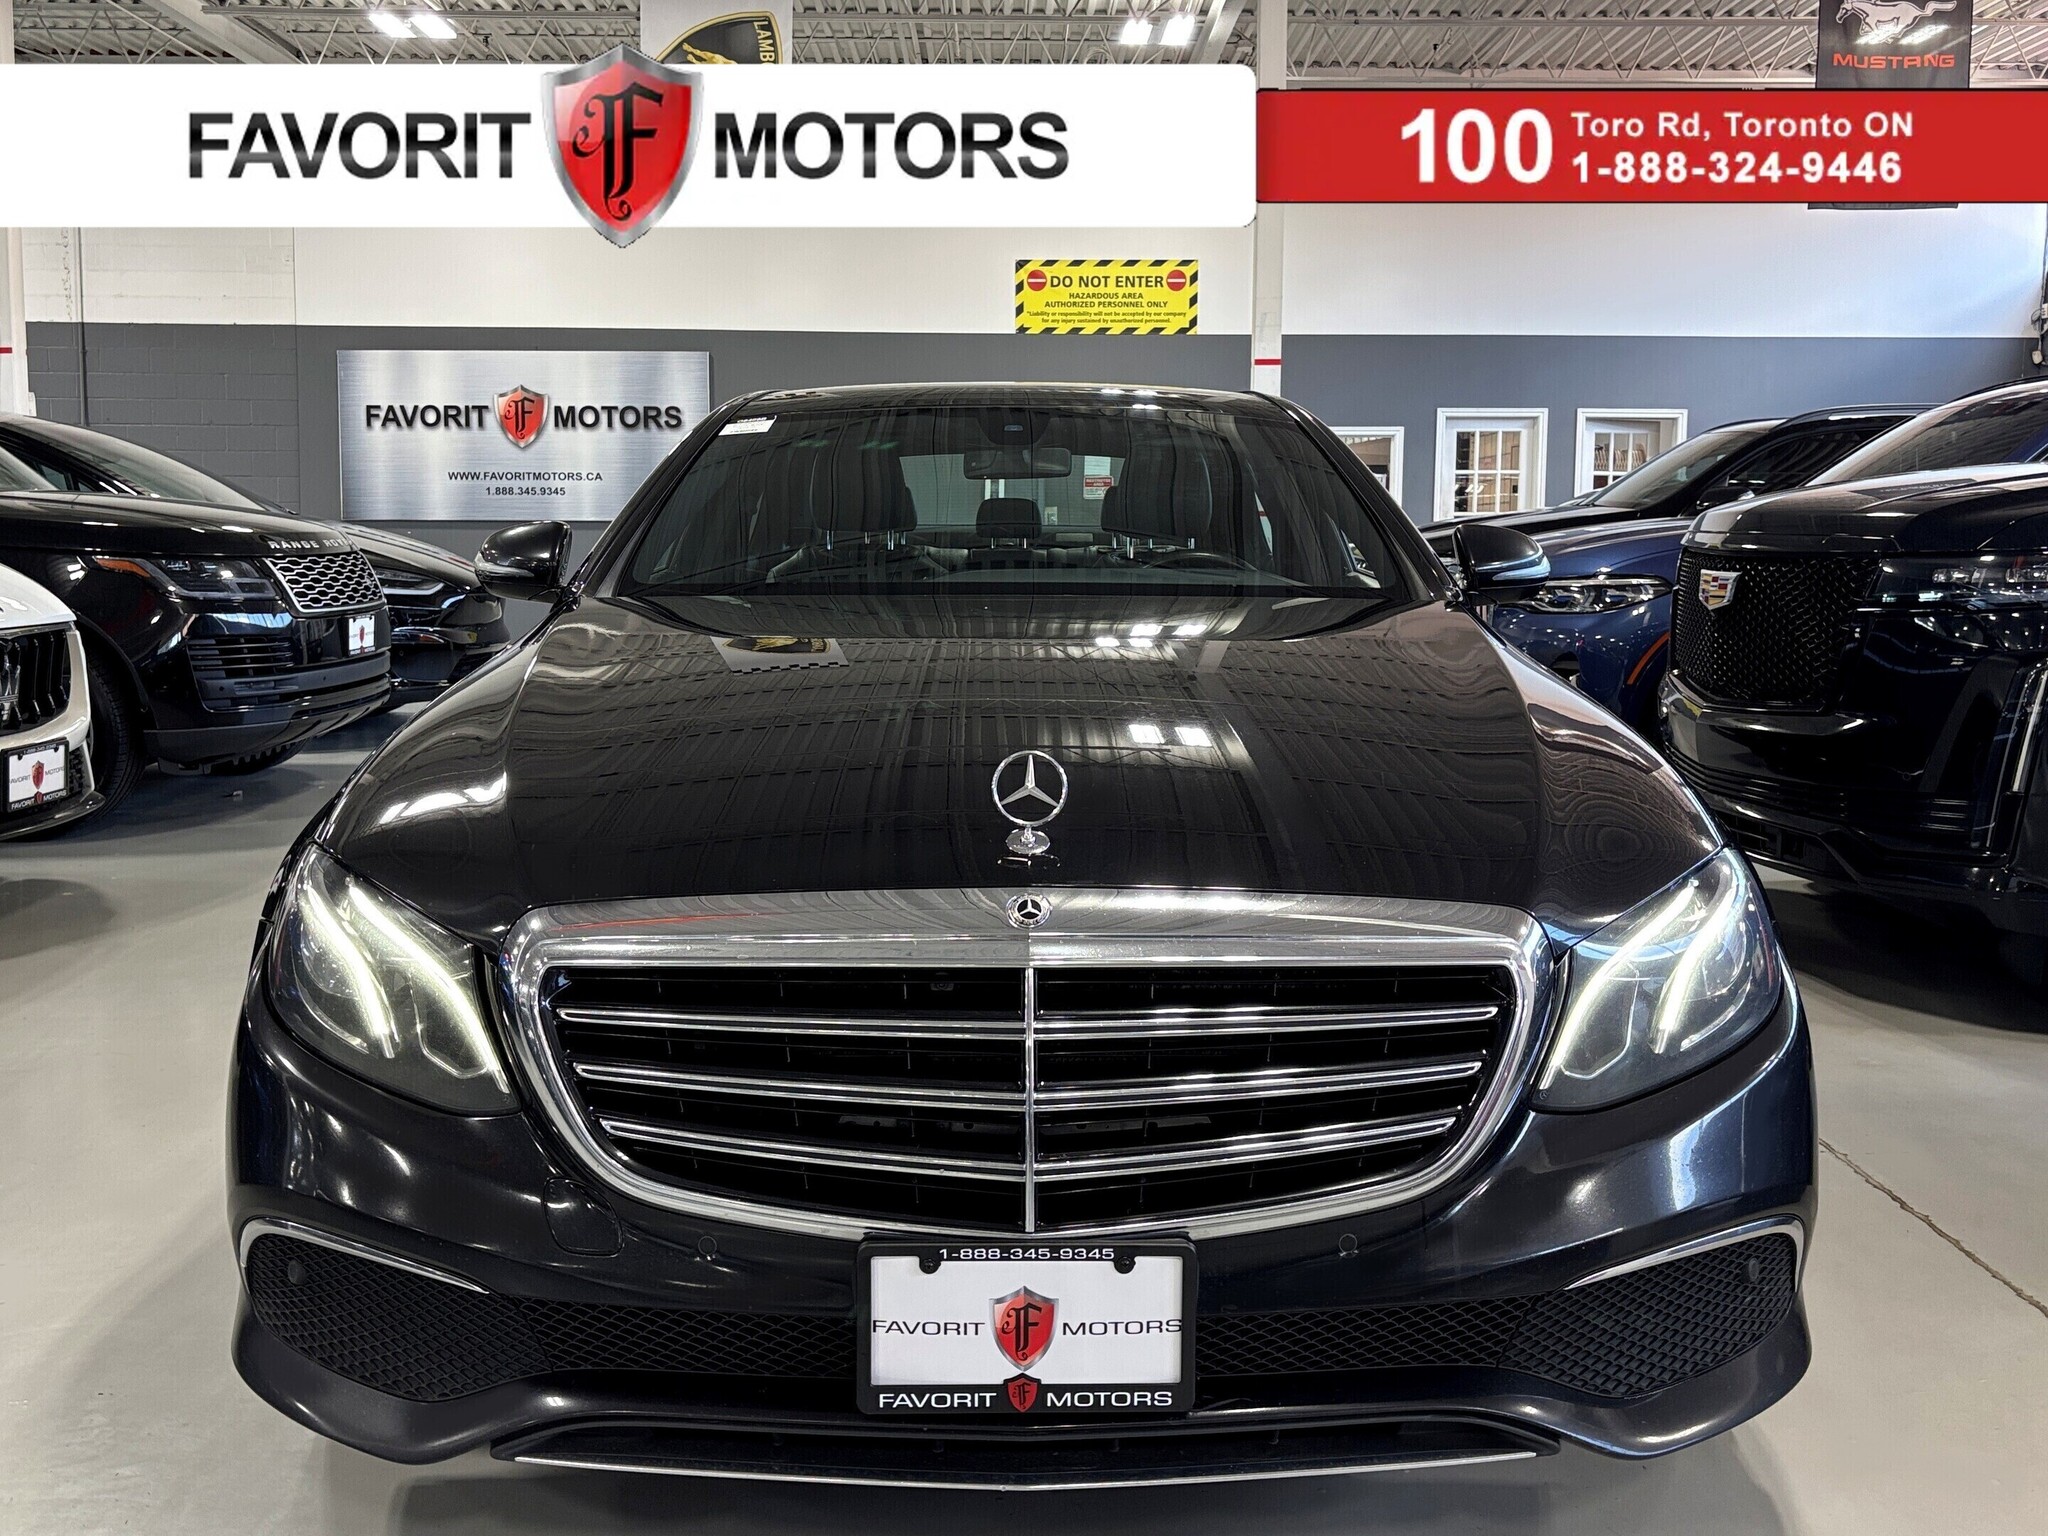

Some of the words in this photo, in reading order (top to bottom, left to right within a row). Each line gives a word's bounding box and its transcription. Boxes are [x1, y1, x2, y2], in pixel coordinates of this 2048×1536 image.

[753, 21, 776, 64] LAMB
[1833, 53, 1955, 69] MUSTANG
[1050, 276, 1073, 288] DO
[1079, 276, 1110, 288] NOT
[1115, 276, 1164, 288] ENTER
[1069, 292, 1119, 300] HAZARDOUS
[1122, 292, 1144, 300] AREA
[366, 404, 489, 428] FAVORIT
[554, 405, 682, 428] MOTORS
[448, 471, 603, 482] WWW.FAVORITMOTORS.CA
[485, 486, 566, 496] 1.888.345.9345
[268, 541, 320, 549] RANGE
[9, 774, 31, 785] AVORIT
[939, 1248, 1114, 1260] 1-888-345-9345
[873, 1320, 985, 1336] FAVORIT
[1062, 1319, 1182, 1336] MOTORS
[879, 1393, 997, 1408] FAVORIT
[1046, 1391, 1172, 1407] MOTORS
